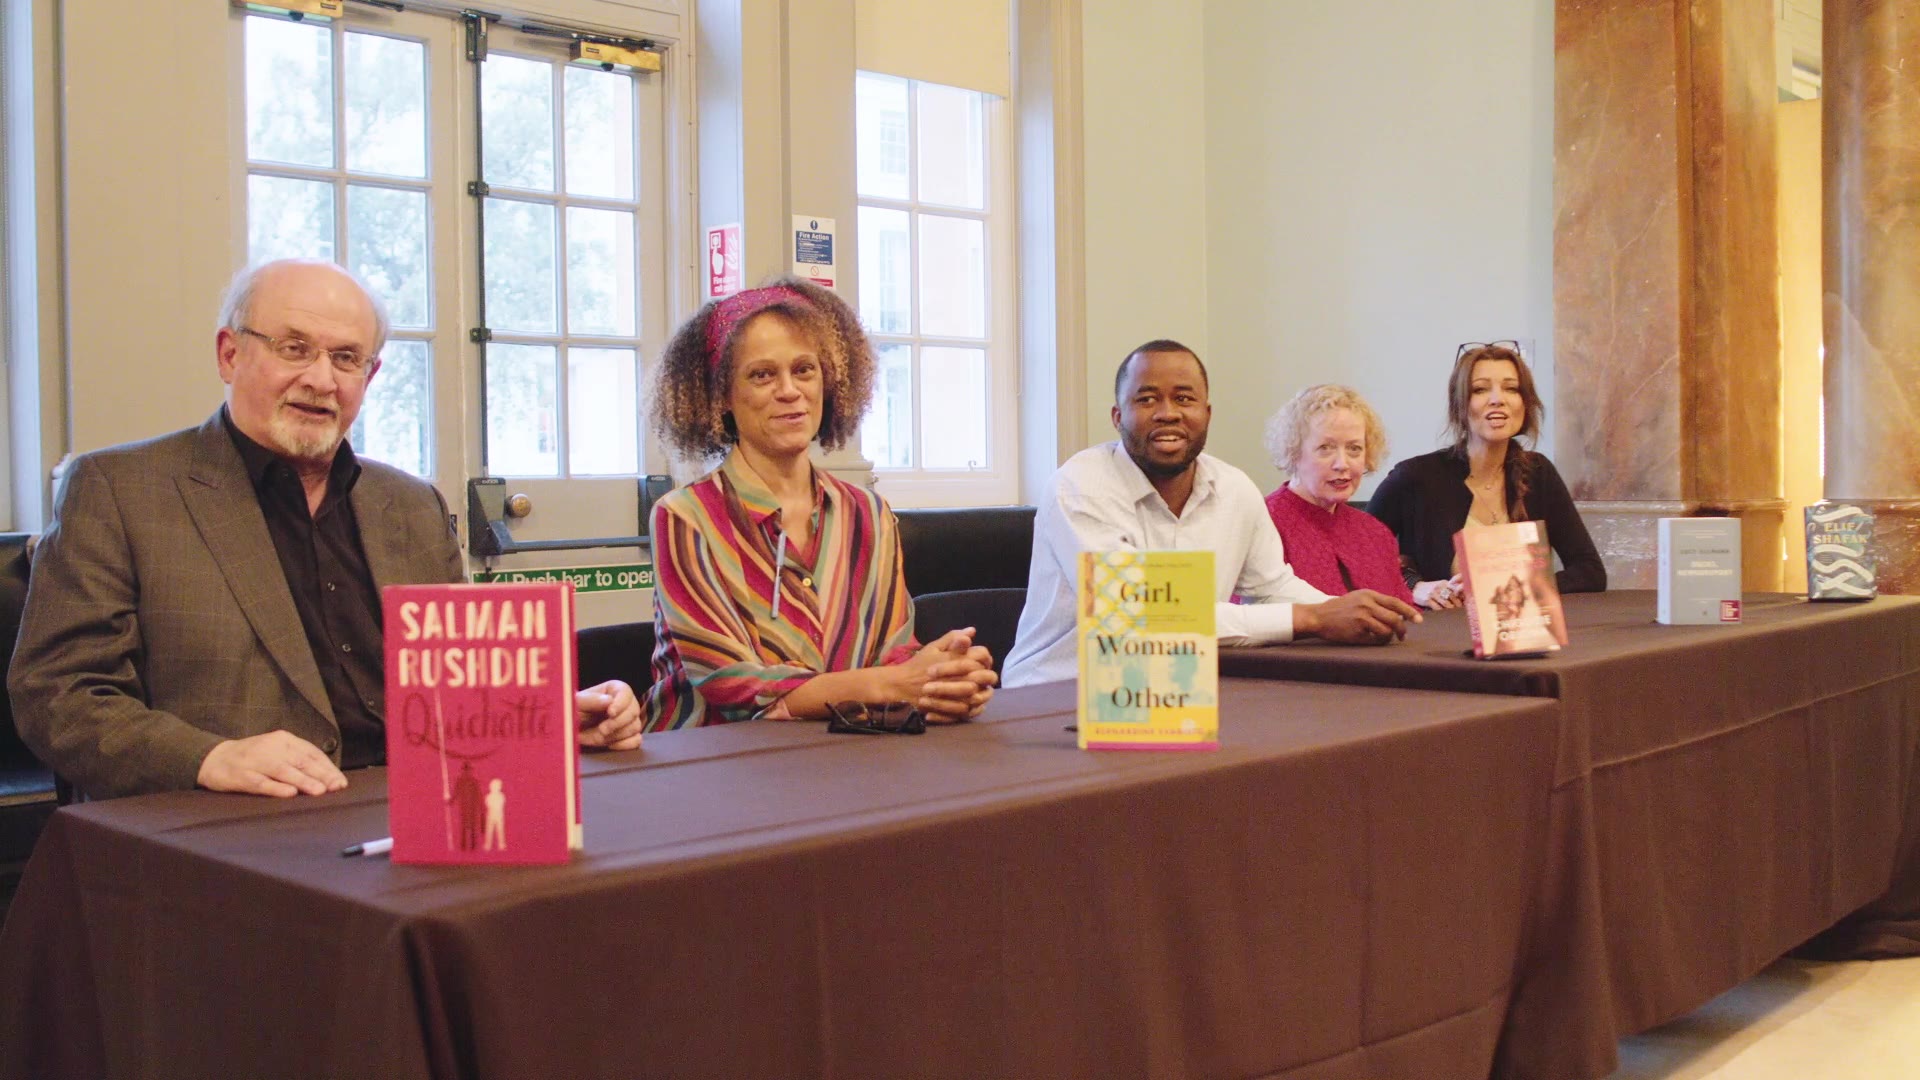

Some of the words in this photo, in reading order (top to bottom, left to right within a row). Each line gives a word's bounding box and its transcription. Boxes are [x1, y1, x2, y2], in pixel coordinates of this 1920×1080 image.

[799, 231, 811, 239] Fire
[1824, 521, 1858, 533] ELIF
[1813, 534, 1869, 545] SHAFAK
[595, 573, 613, 587] to
[1120, 581, 1180, 606] Girl,
[400, 600, 547, 641] SALMAN
[1096, 634, 1205, 657] Woman,
[398, 647, 549, 688] RUSHDIE
[1111, 687, 1190, 709] Other
